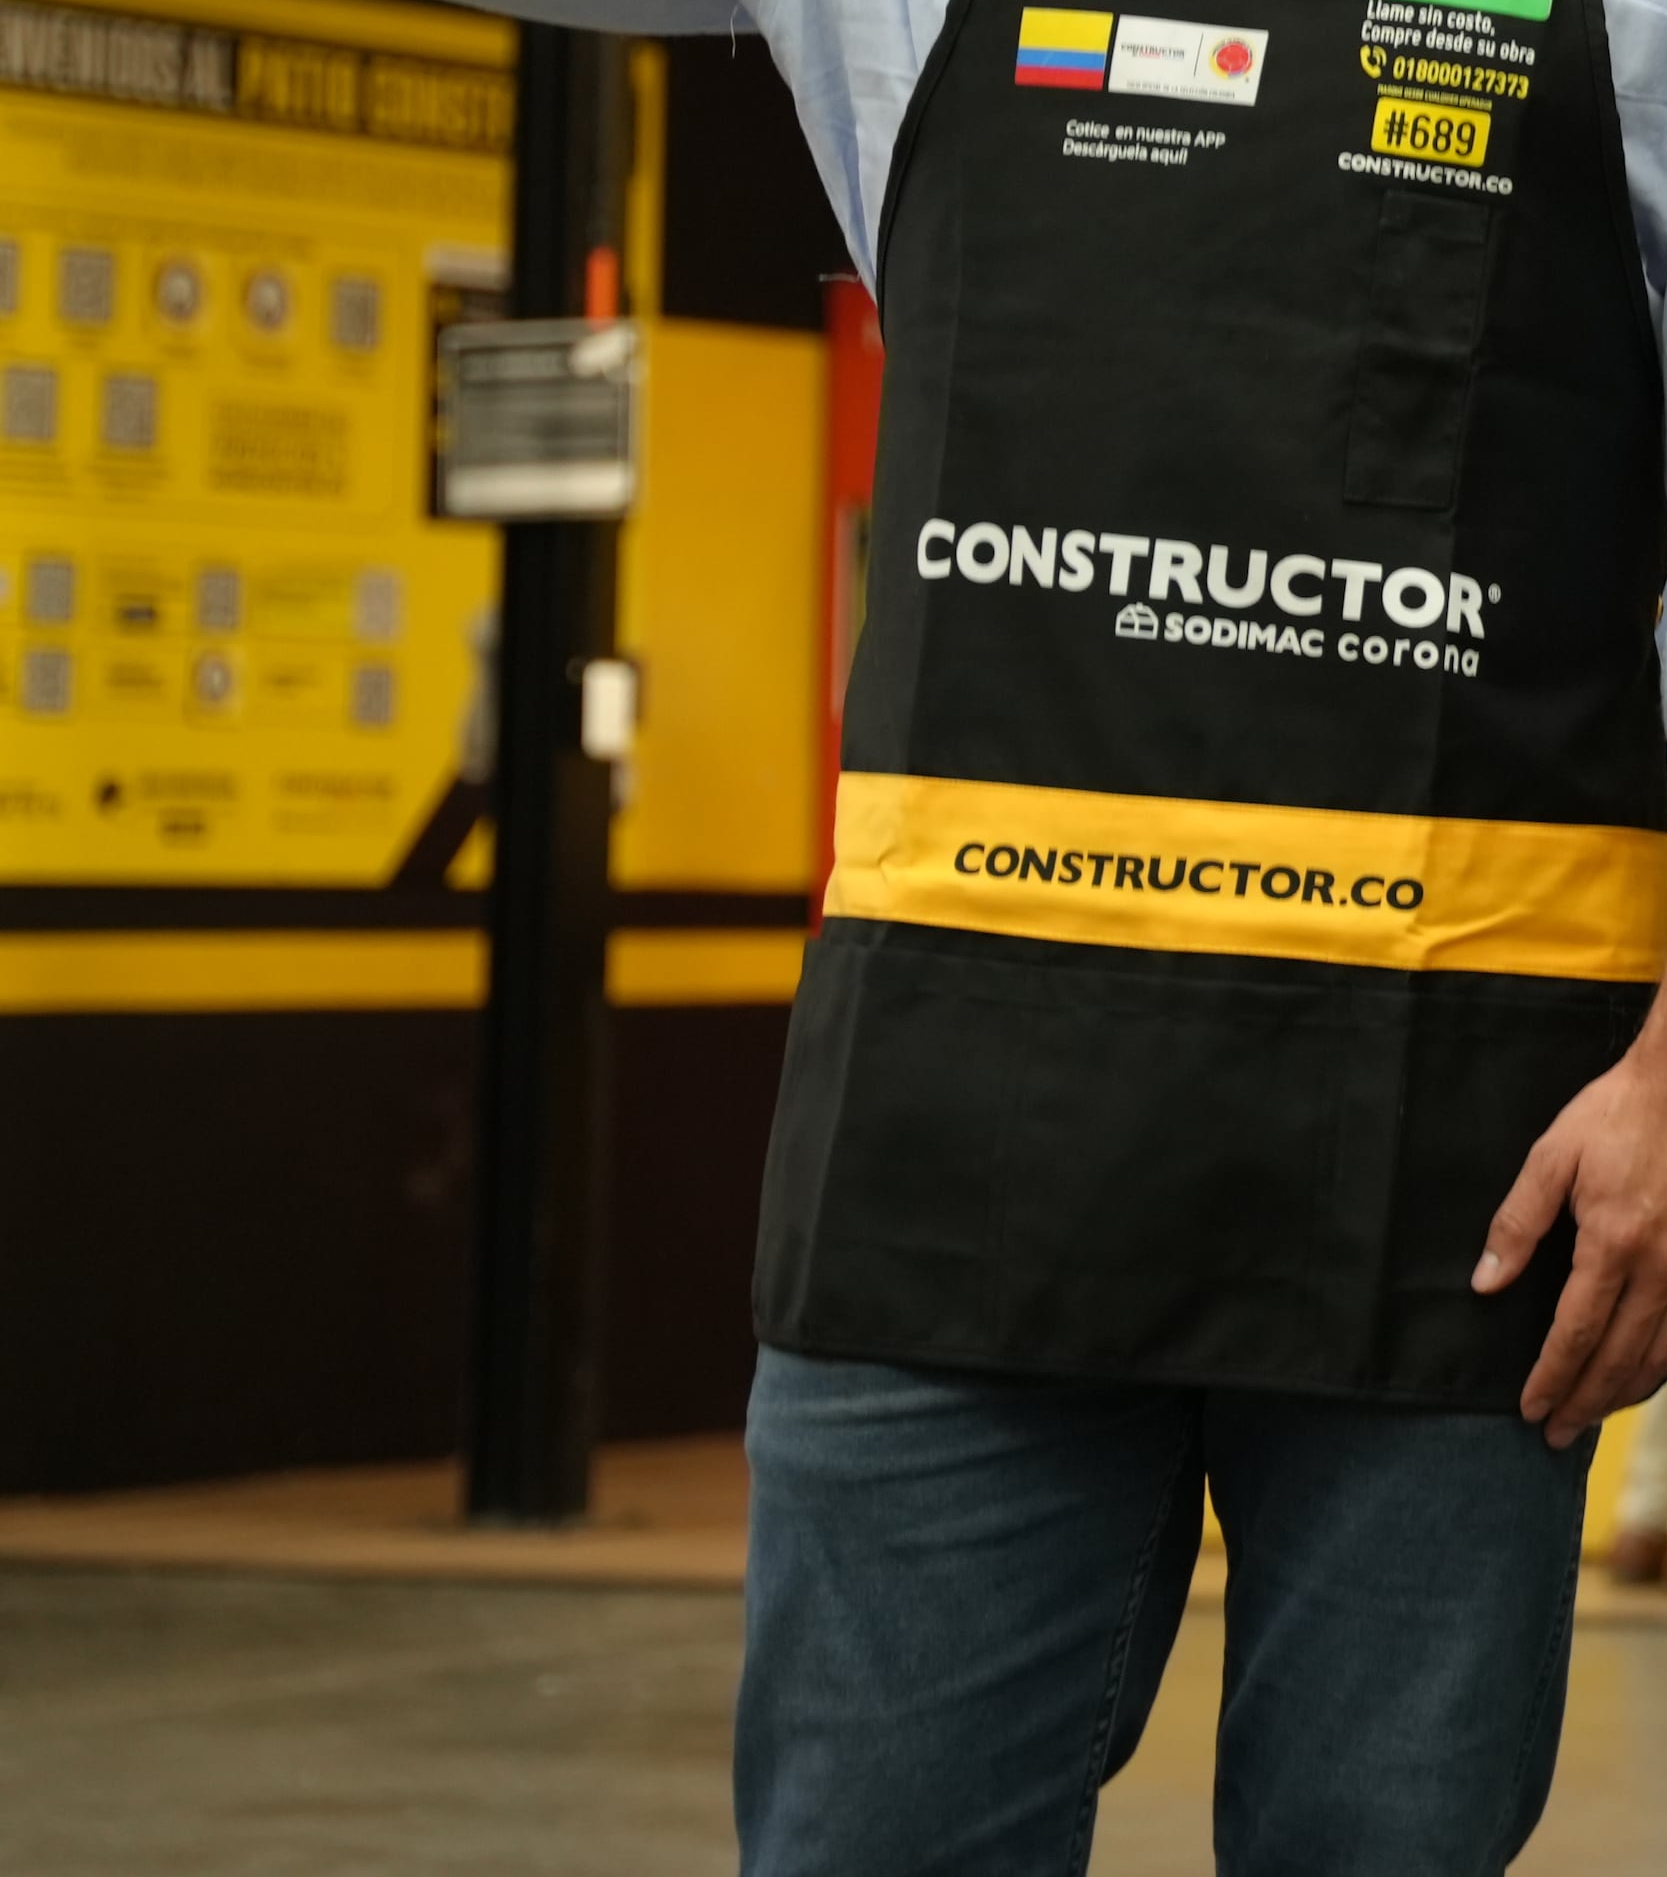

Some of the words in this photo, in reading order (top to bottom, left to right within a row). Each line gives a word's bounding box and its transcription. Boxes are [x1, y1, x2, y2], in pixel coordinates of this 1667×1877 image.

[1361, 19, 1421, 49] Compre
[1425, 27, 1473, 53] desde
[1477, 37, 1496, 58] su
[1500, 40, 1535, 66] obra
[1419, 4, 1442, 27] sin
[1447, 11, 1495, 36] costo,
[1393, 55, 1529, 100] 018000127373
[1066, 119, 1110, 139] Cotice
[1115, 125, 1133, 141] en
[1136, 126, 1192, 146] nuestra
[1194, 130, 1226, 149] APP
[1384, 109, 1476, 156] #689
[1338, 152, 1513, 195] CONSTRUCTOR.CO
[1163, 612, 1325, 658] SODIMAC
[1337, 633, 1480, 677] corona
[954, 841, 1426, 911] CONSTRUCTOR.CO
